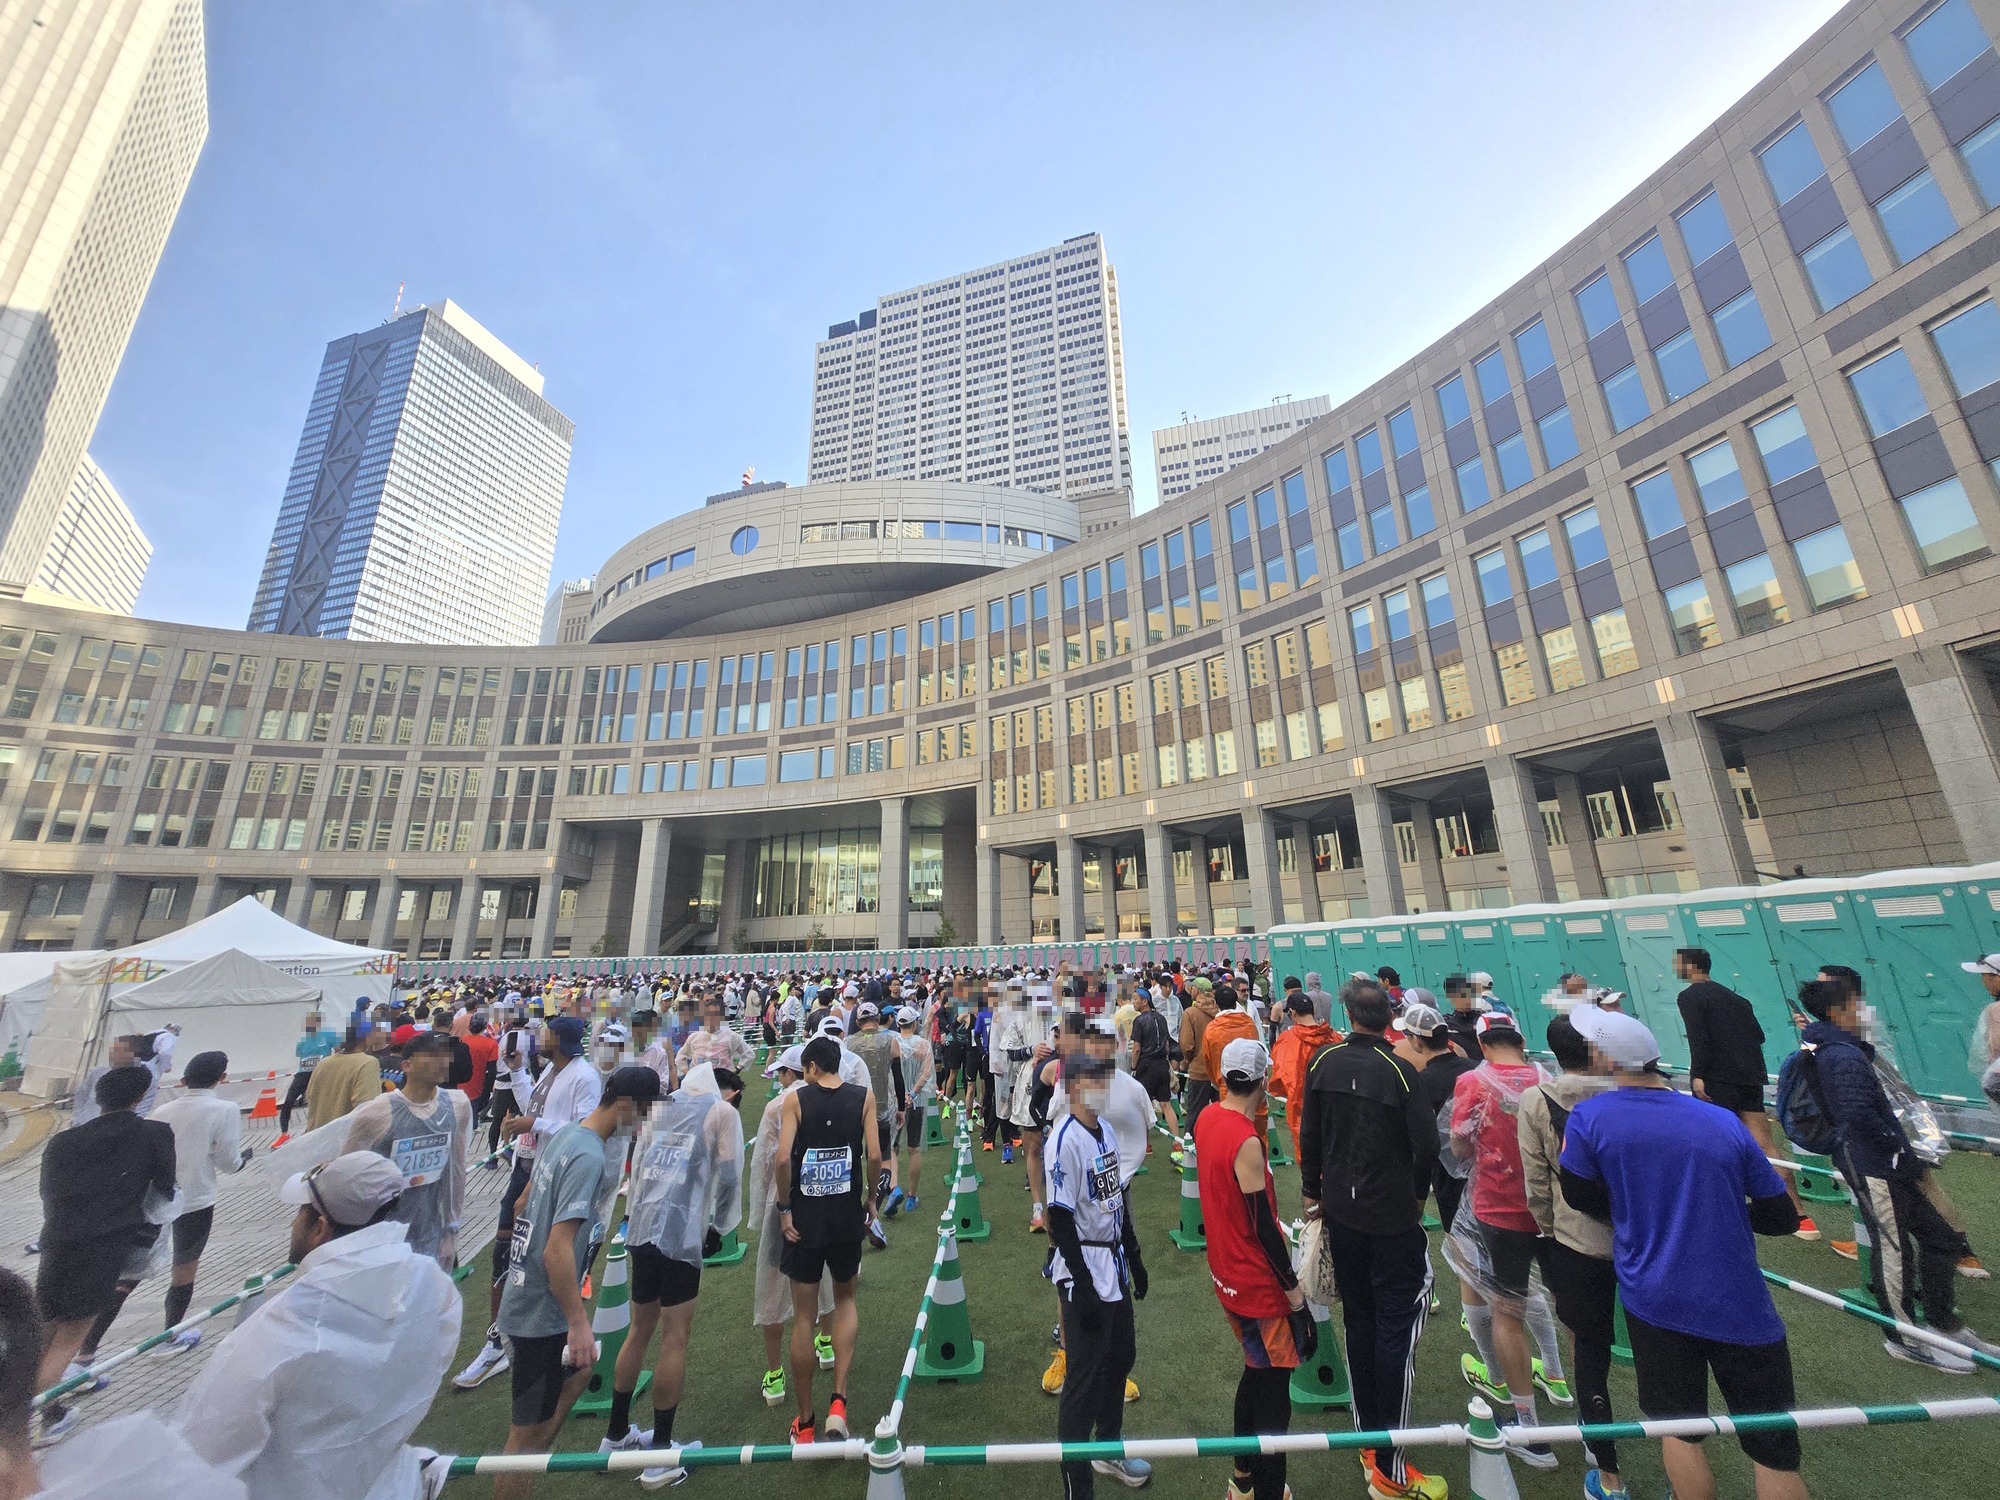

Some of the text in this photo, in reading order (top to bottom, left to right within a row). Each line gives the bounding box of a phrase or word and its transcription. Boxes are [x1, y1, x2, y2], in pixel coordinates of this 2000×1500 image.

[402, 1150, 442, 1173] 21855
[812, 1163, 842, 1181] 3050
[1097, 1177, 1105, 1189] G
